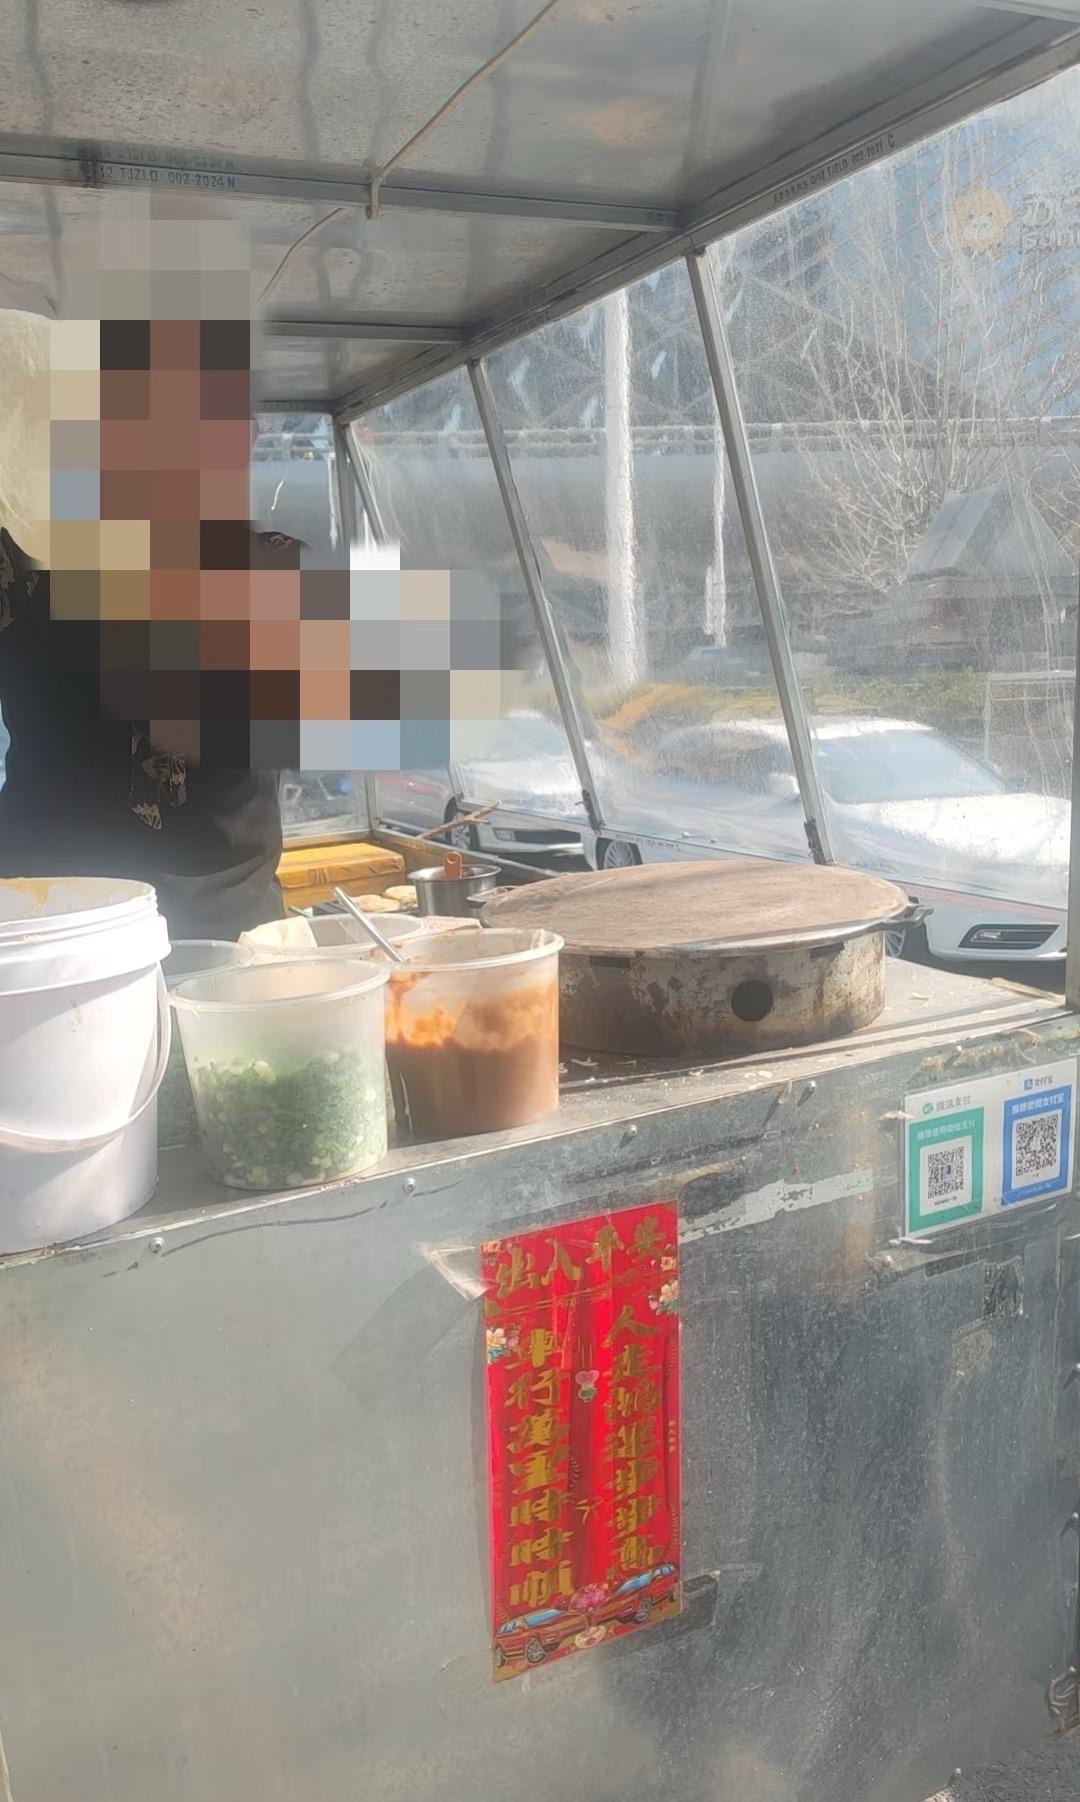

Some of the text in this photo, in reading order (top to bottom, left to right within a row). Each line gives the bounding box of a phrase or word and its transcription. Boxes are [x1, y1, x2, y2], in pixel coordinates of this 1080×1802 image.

[937, 1096, 971, 1113] 微信支付
[497, 1217, 665, 1298] 出入平安
